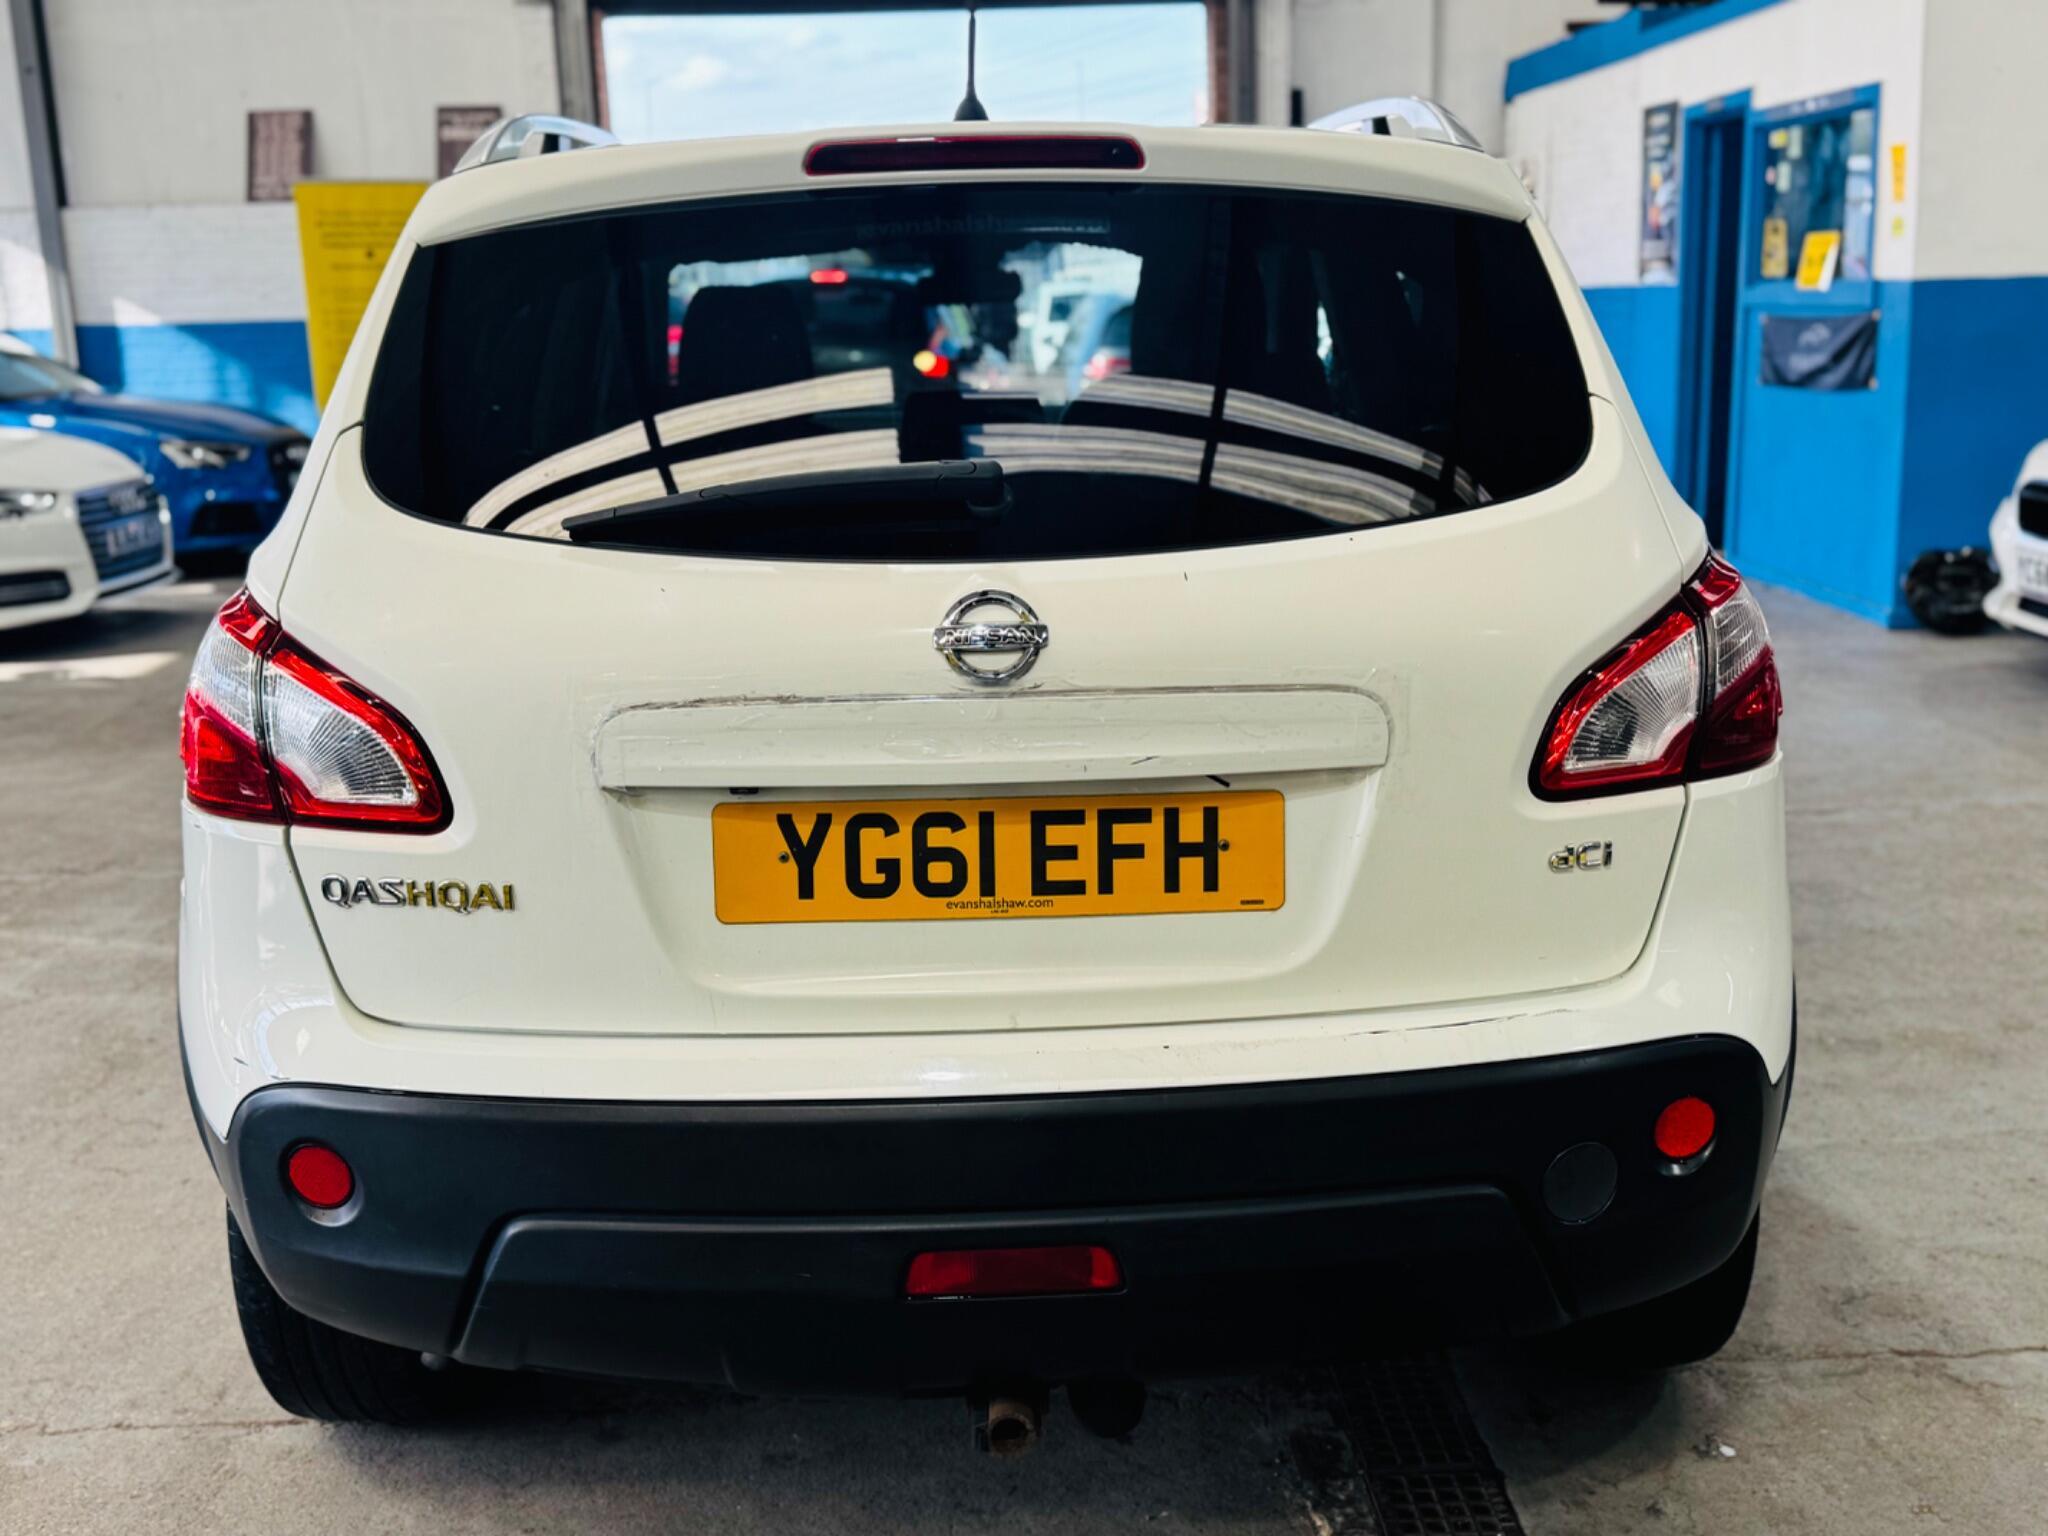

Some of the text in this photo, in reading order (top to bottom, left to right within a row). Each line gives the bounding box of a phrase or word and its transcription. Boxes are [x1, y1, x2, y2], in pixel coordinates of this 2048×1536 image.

[939, 627, 1042, 646] NISSAN
[776, 806, 1219, 900] YG61 EFH
[1548, 840, 1613, 872] dCi
[320, 872, 516, 914] QASHQAI
[945, 896, 1054, 909] evanshalshaw.com
